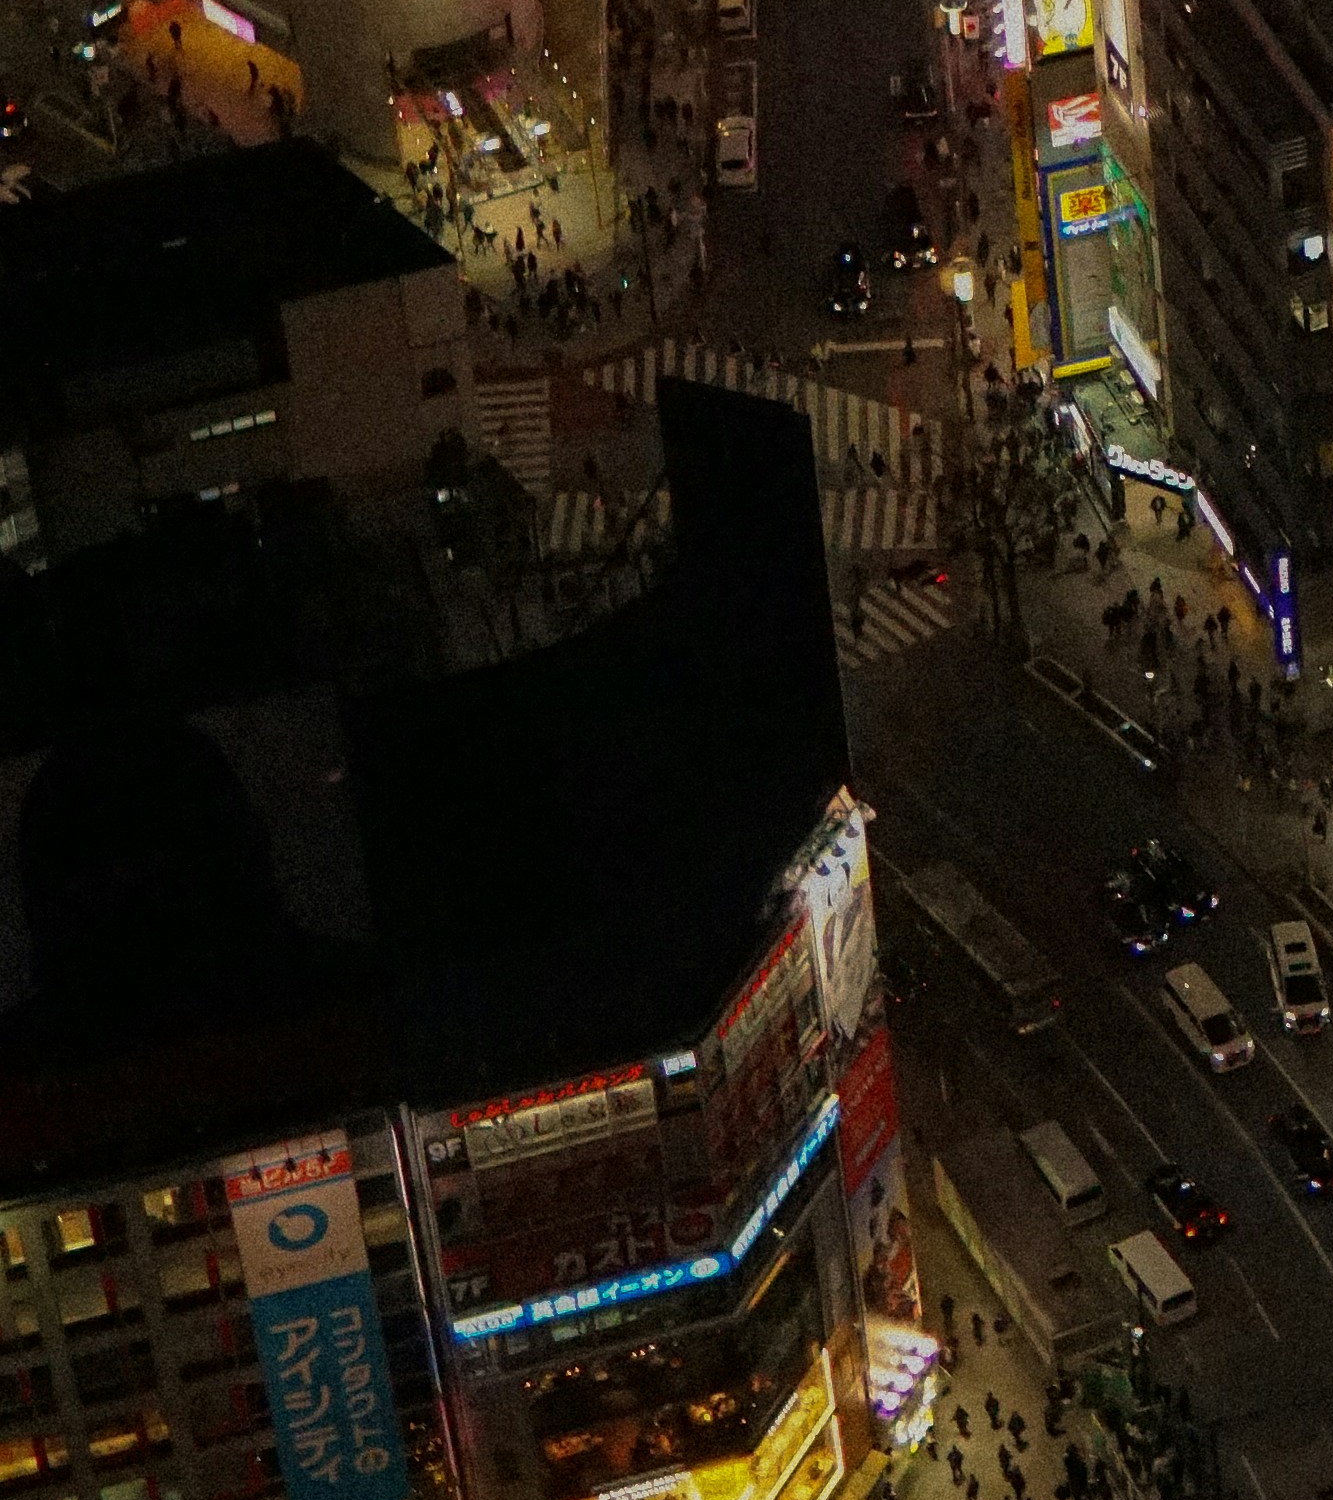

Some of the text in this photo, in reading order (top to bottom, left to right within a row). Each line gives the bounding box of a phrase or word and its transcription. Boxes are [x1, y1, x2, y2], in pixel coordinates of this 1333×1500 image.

[430, 1139, 463, 1165] 9F
[272, 1317, 345, 1484] アイシティ
[331, 1303, 392, 1460] コンタクトの
